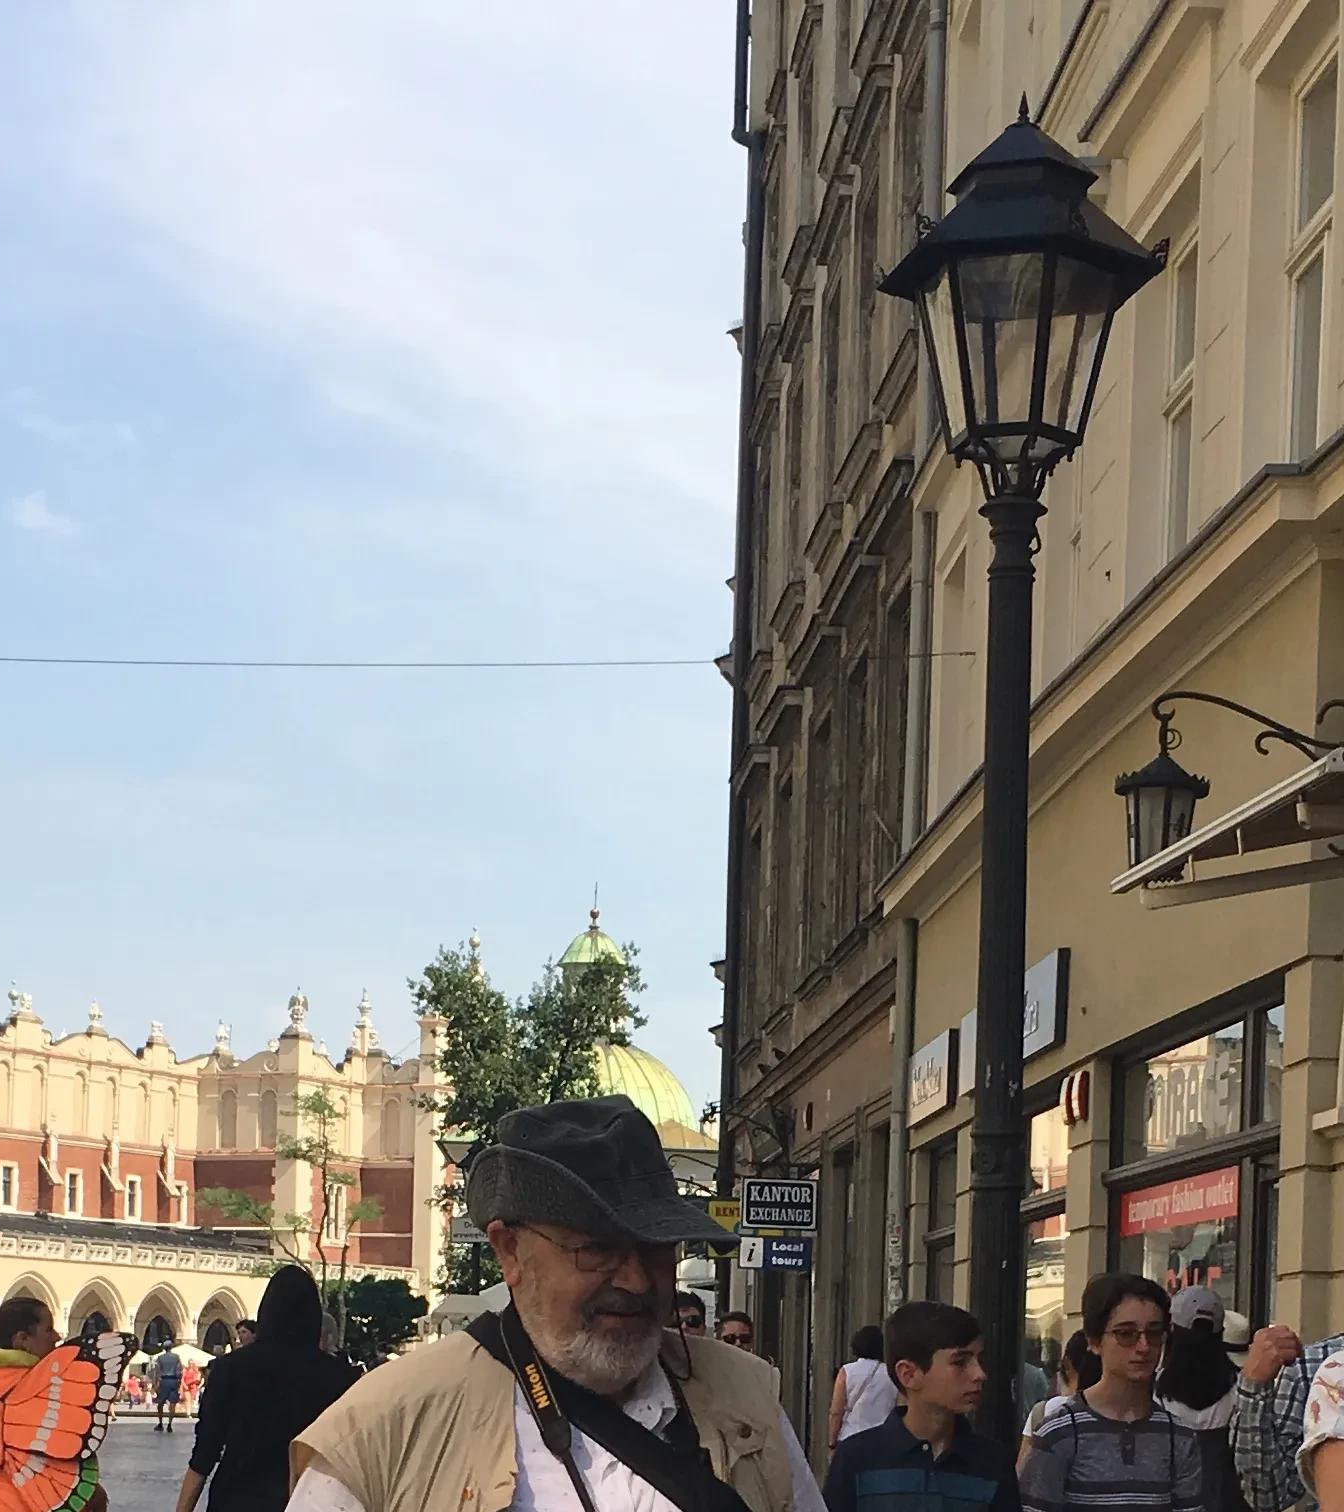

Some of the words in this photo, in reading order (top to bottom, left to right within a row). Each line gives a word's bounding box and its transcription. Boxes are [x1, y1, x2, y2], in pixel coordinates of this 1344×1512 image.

[749, 1185, 811, 1203] KANTOR
[1128, 1195, 1170, 1230] temporary
[1171, 1181, 1204, 1214] fashion
[1205, 1173, 1235, 1208] outlet
[749, 1207, 811, 1222] EXCHANGE
[772, 1242, 804, 1252] Local
[772, 1256, 803, 1266] tours
[524, 1362, 552, 1409] Nikon
